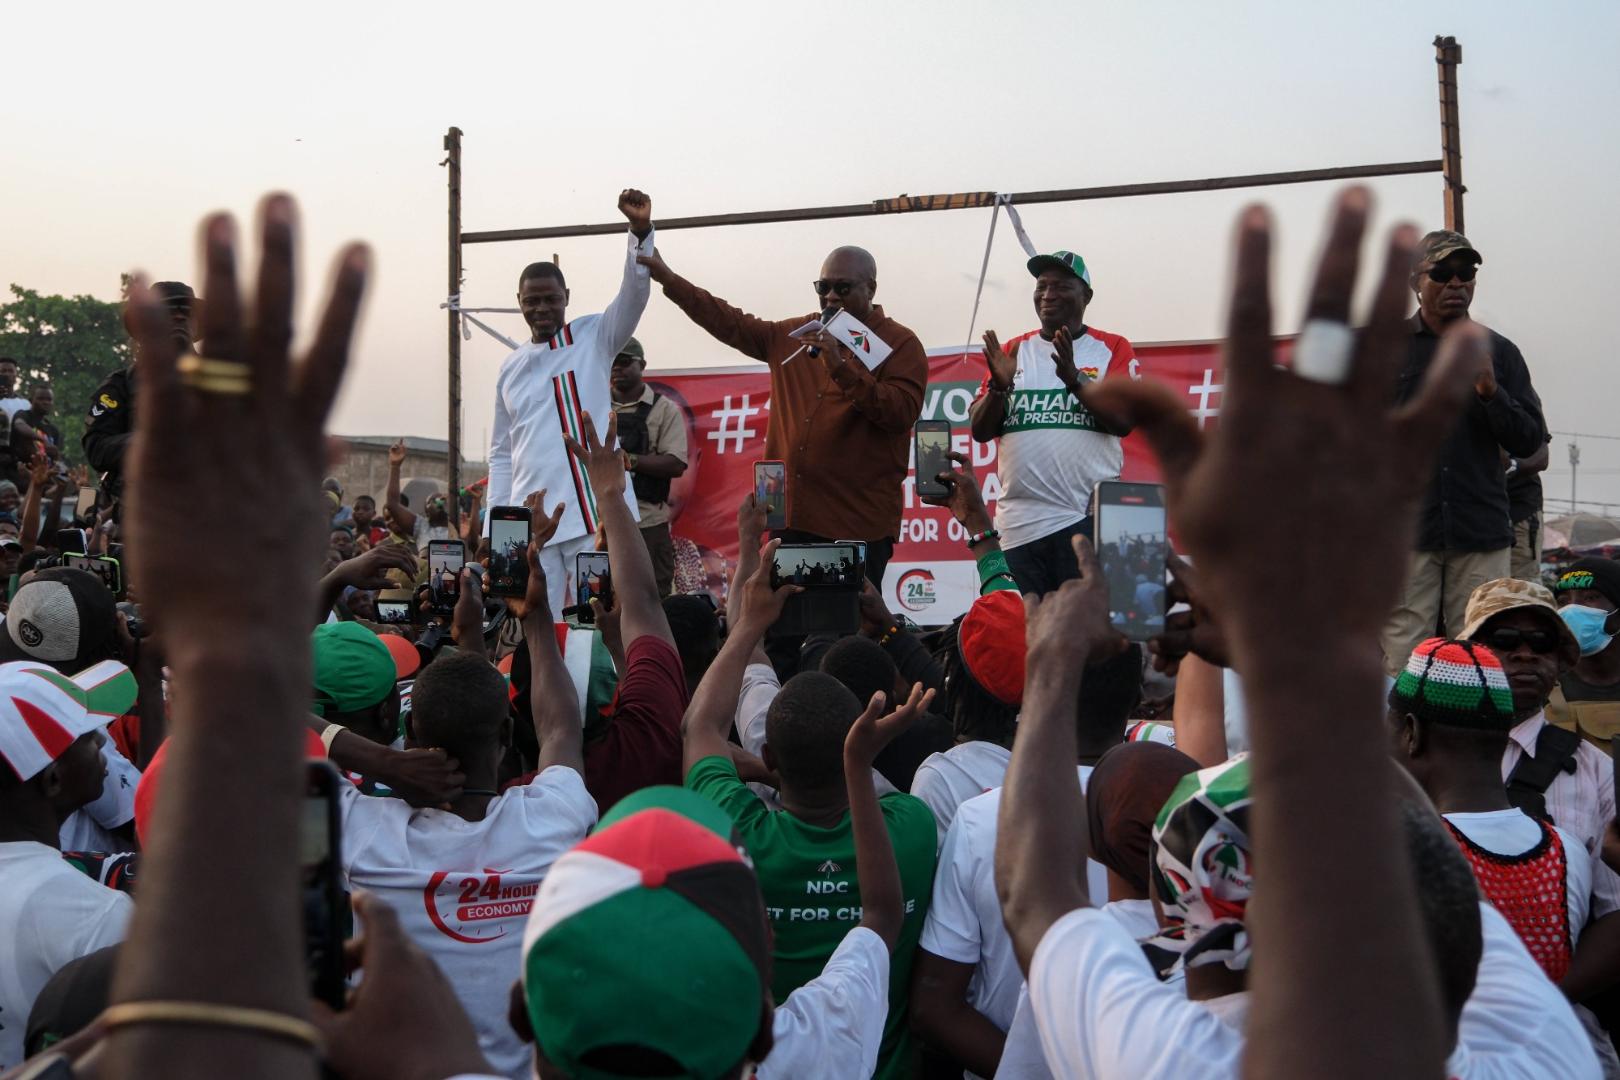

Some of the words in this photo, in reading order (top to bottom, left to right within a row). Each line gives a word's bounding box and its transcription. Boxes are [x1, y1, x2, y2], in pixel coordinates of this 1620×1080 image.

[920, 388, 984, 422] VO
[1023, 411, 1096, 427] PRESIDENT
[899, 518, 938, 543] FOR
[908, 583, 923, 597] 24
[458, 875, 501, 904] 24
[806, 880, 848, 894] NDC
[467, 902, 530, 919] ECONOMY
[790, 907, 829, 921] FOR
